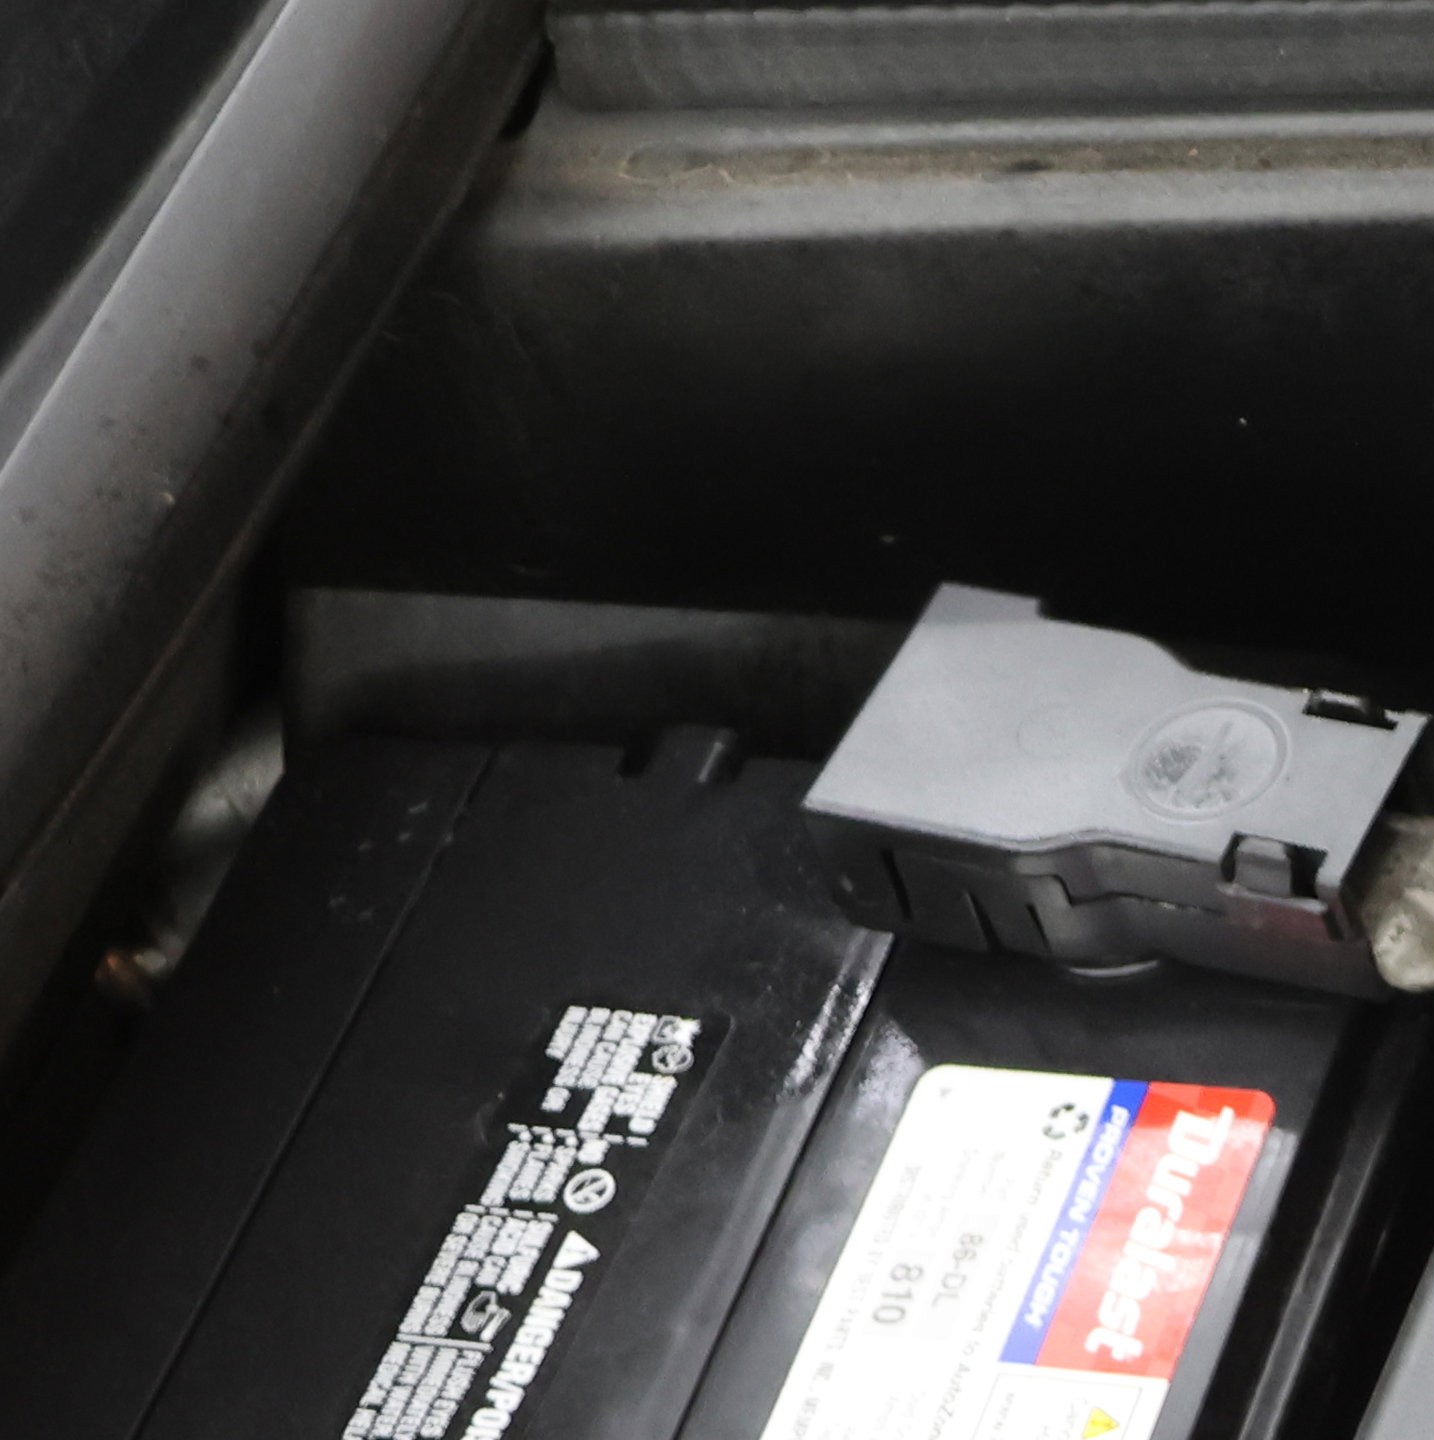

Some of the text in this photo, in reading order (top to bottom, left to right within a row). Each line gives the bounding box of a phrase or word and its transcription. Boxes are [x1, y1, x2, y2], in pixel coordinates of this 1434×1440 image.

[869, 1265, 924, 1321] 810
[1024, 1107, 1128, 1325] PROVEN TOUGH
[1084, 1112, 1235, 1354] Duralast
